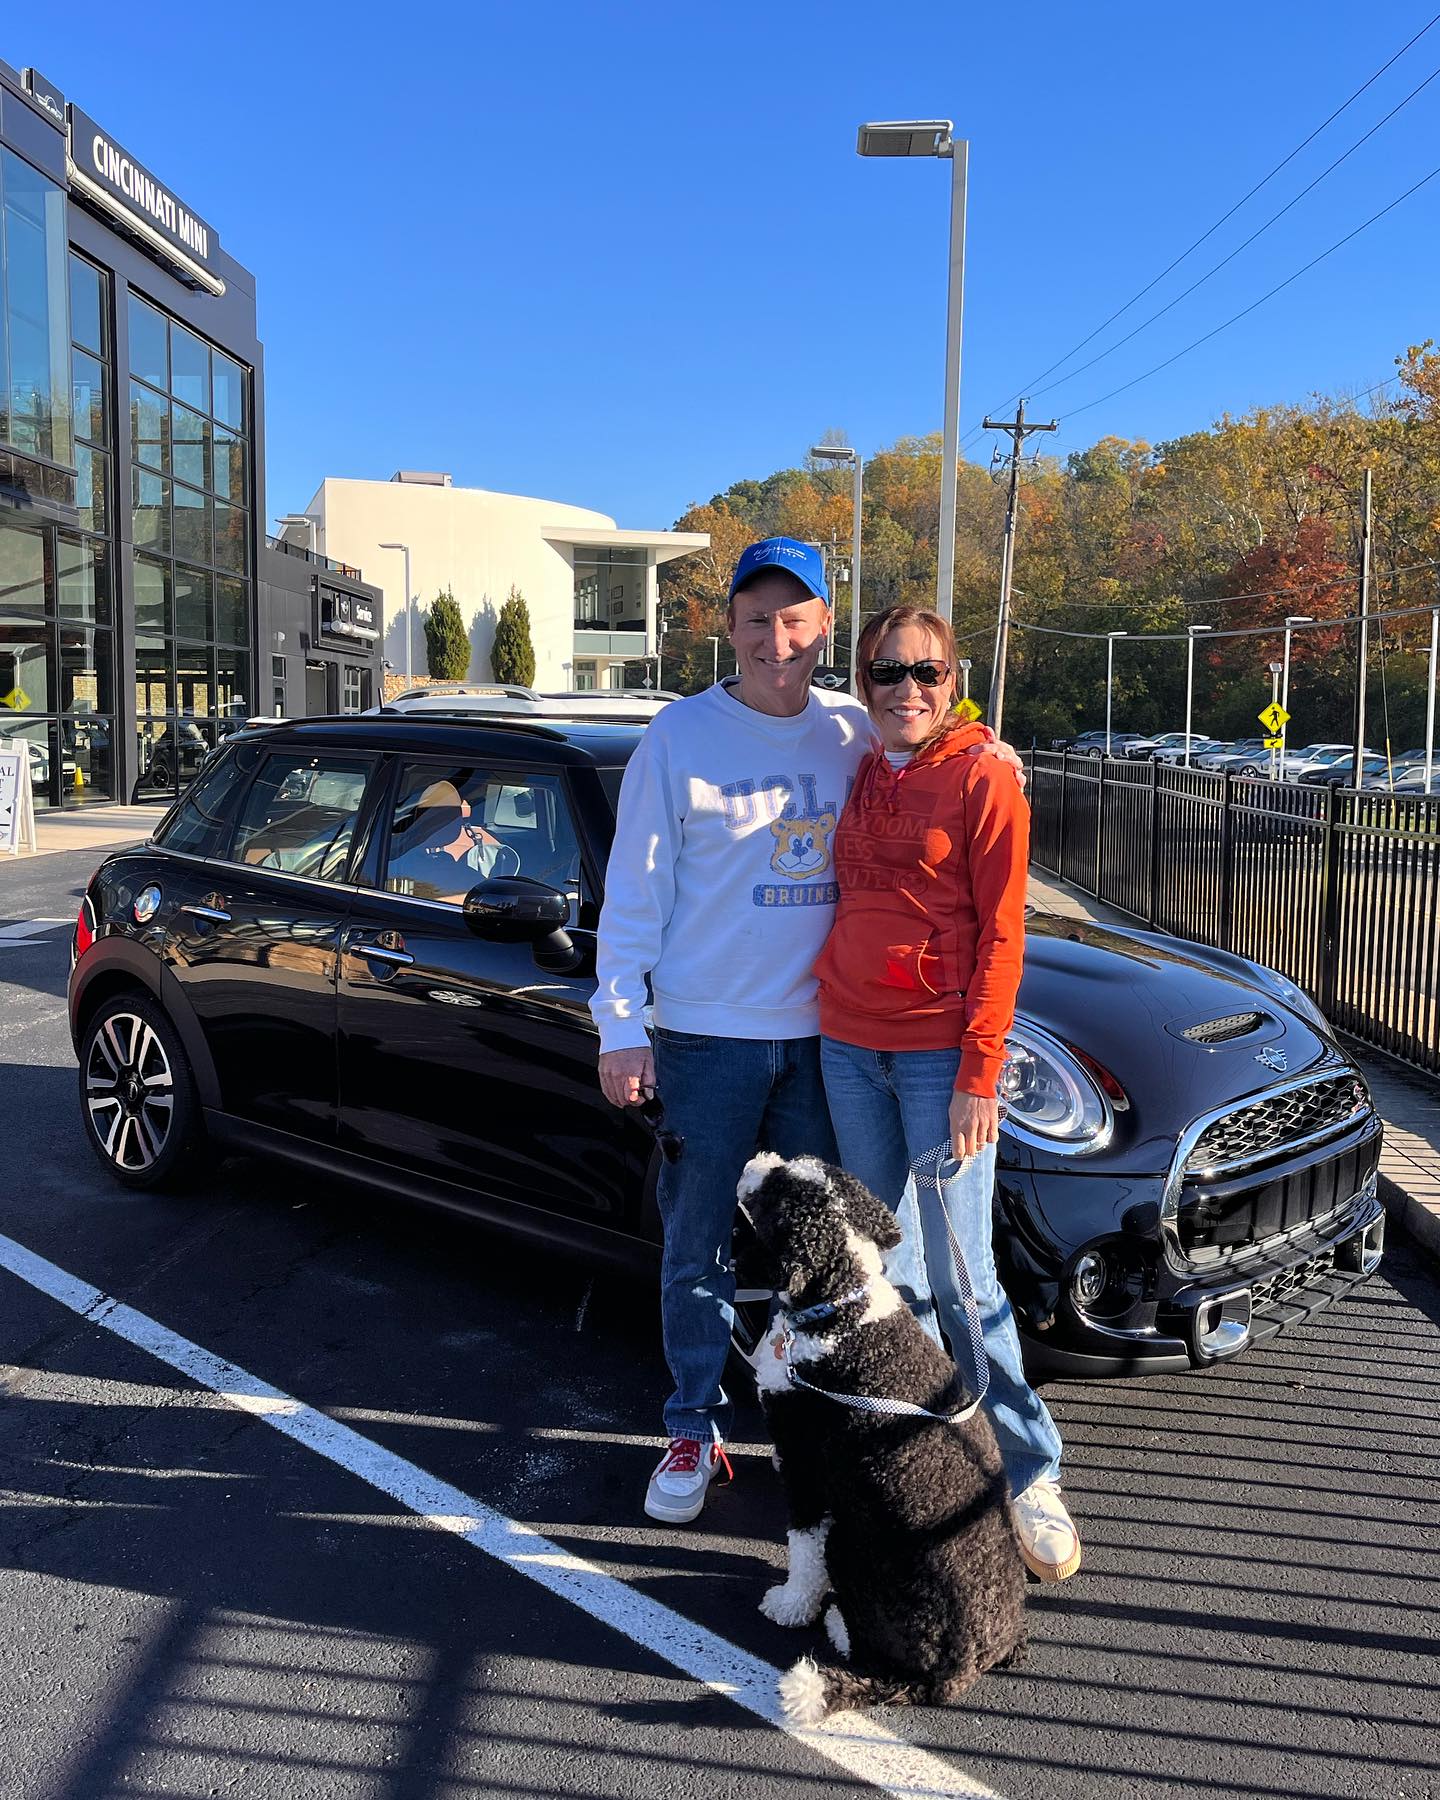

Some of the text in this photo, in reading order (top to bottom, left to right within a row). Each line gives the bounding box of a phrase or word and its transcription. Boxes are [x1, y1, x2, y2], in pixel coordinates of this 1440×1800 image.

[93, 135, 208, 259] CINCINNATI MINI
[719, 774, 855, 830] UCL
[764, 886, 835, 905] BRUINS
